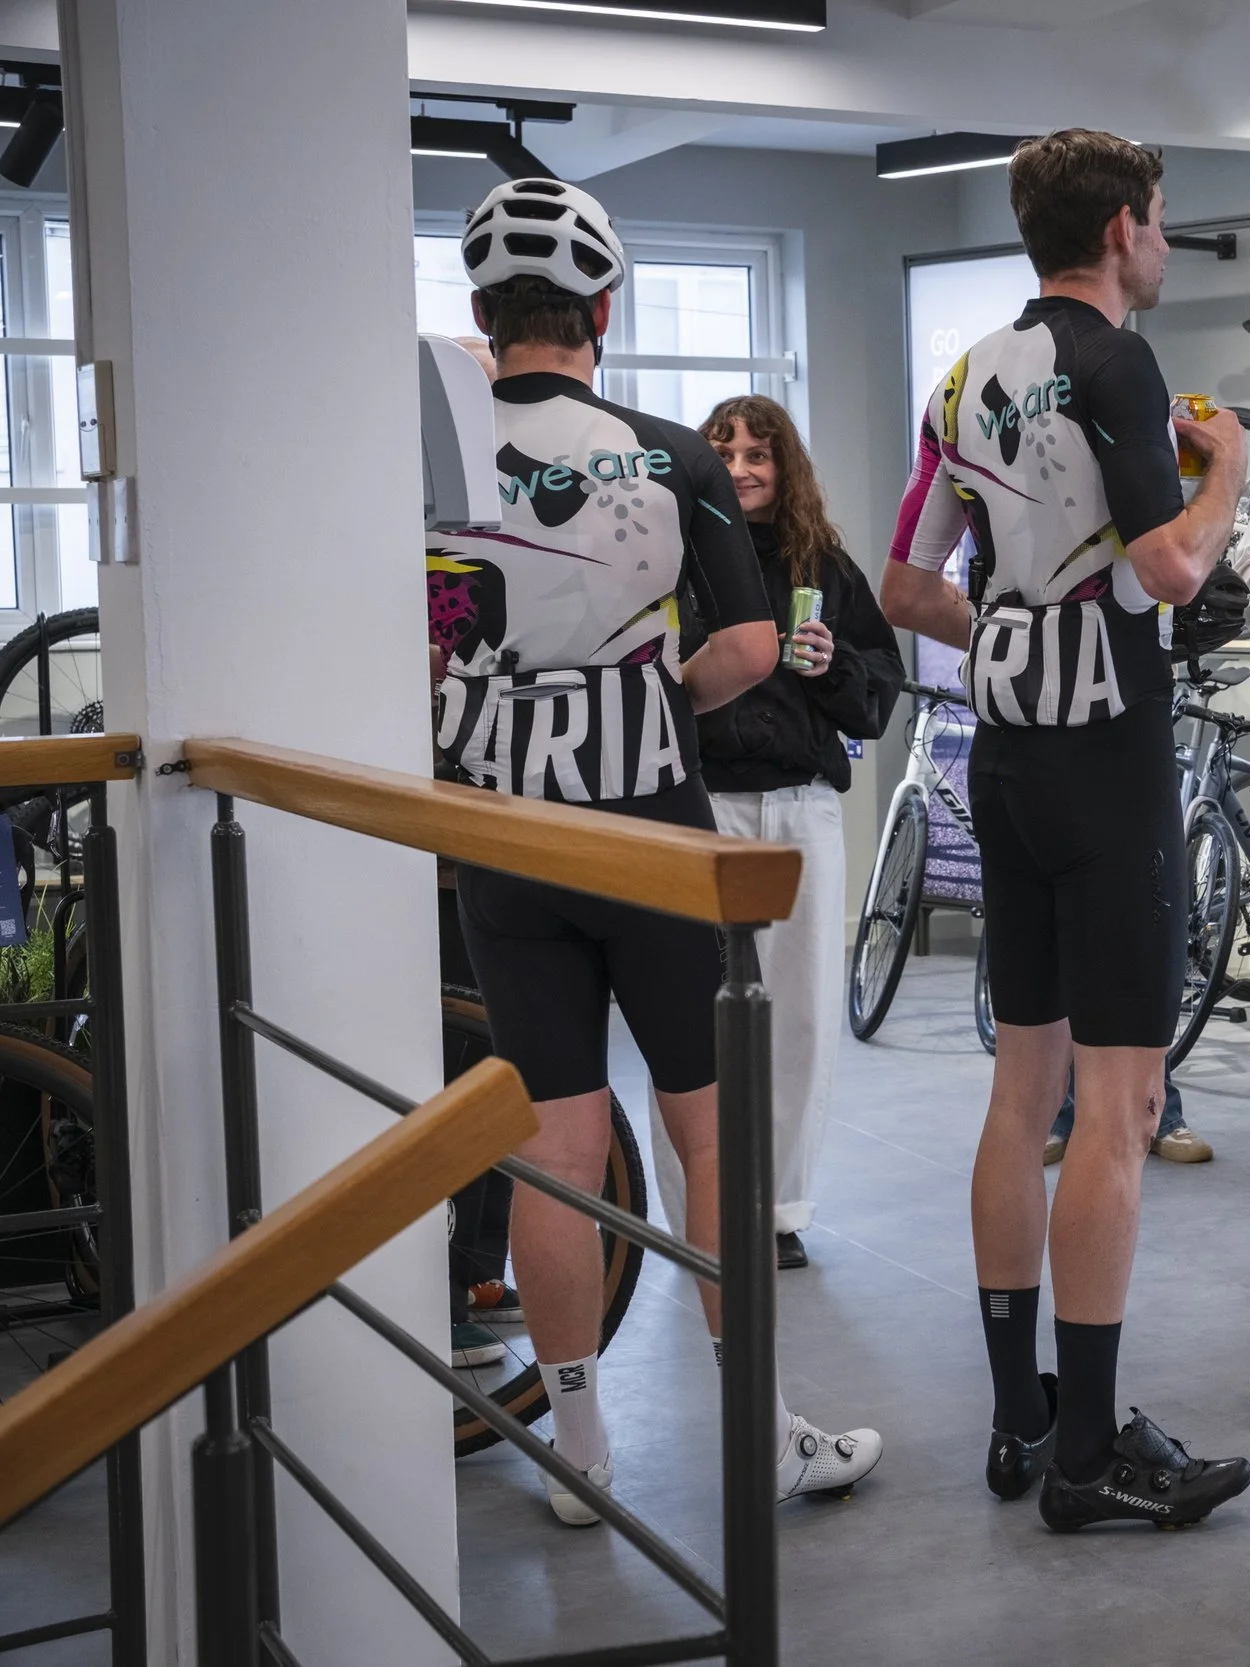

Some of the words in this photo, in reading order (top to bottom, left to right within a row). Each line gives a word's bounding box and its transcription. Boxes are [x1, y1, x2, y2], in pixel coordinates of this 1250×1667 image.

[930, 328, 960, 357] GO
[975, 400, 1017, 440] we
[1022, 374, 1072, 419] are
[497, 464, 574, 505] we
[588, 449, 672, 481] are
[558, 1364, 587, 1393] MCR
[1098, 1485, 1175, 1514] S-WORKS
